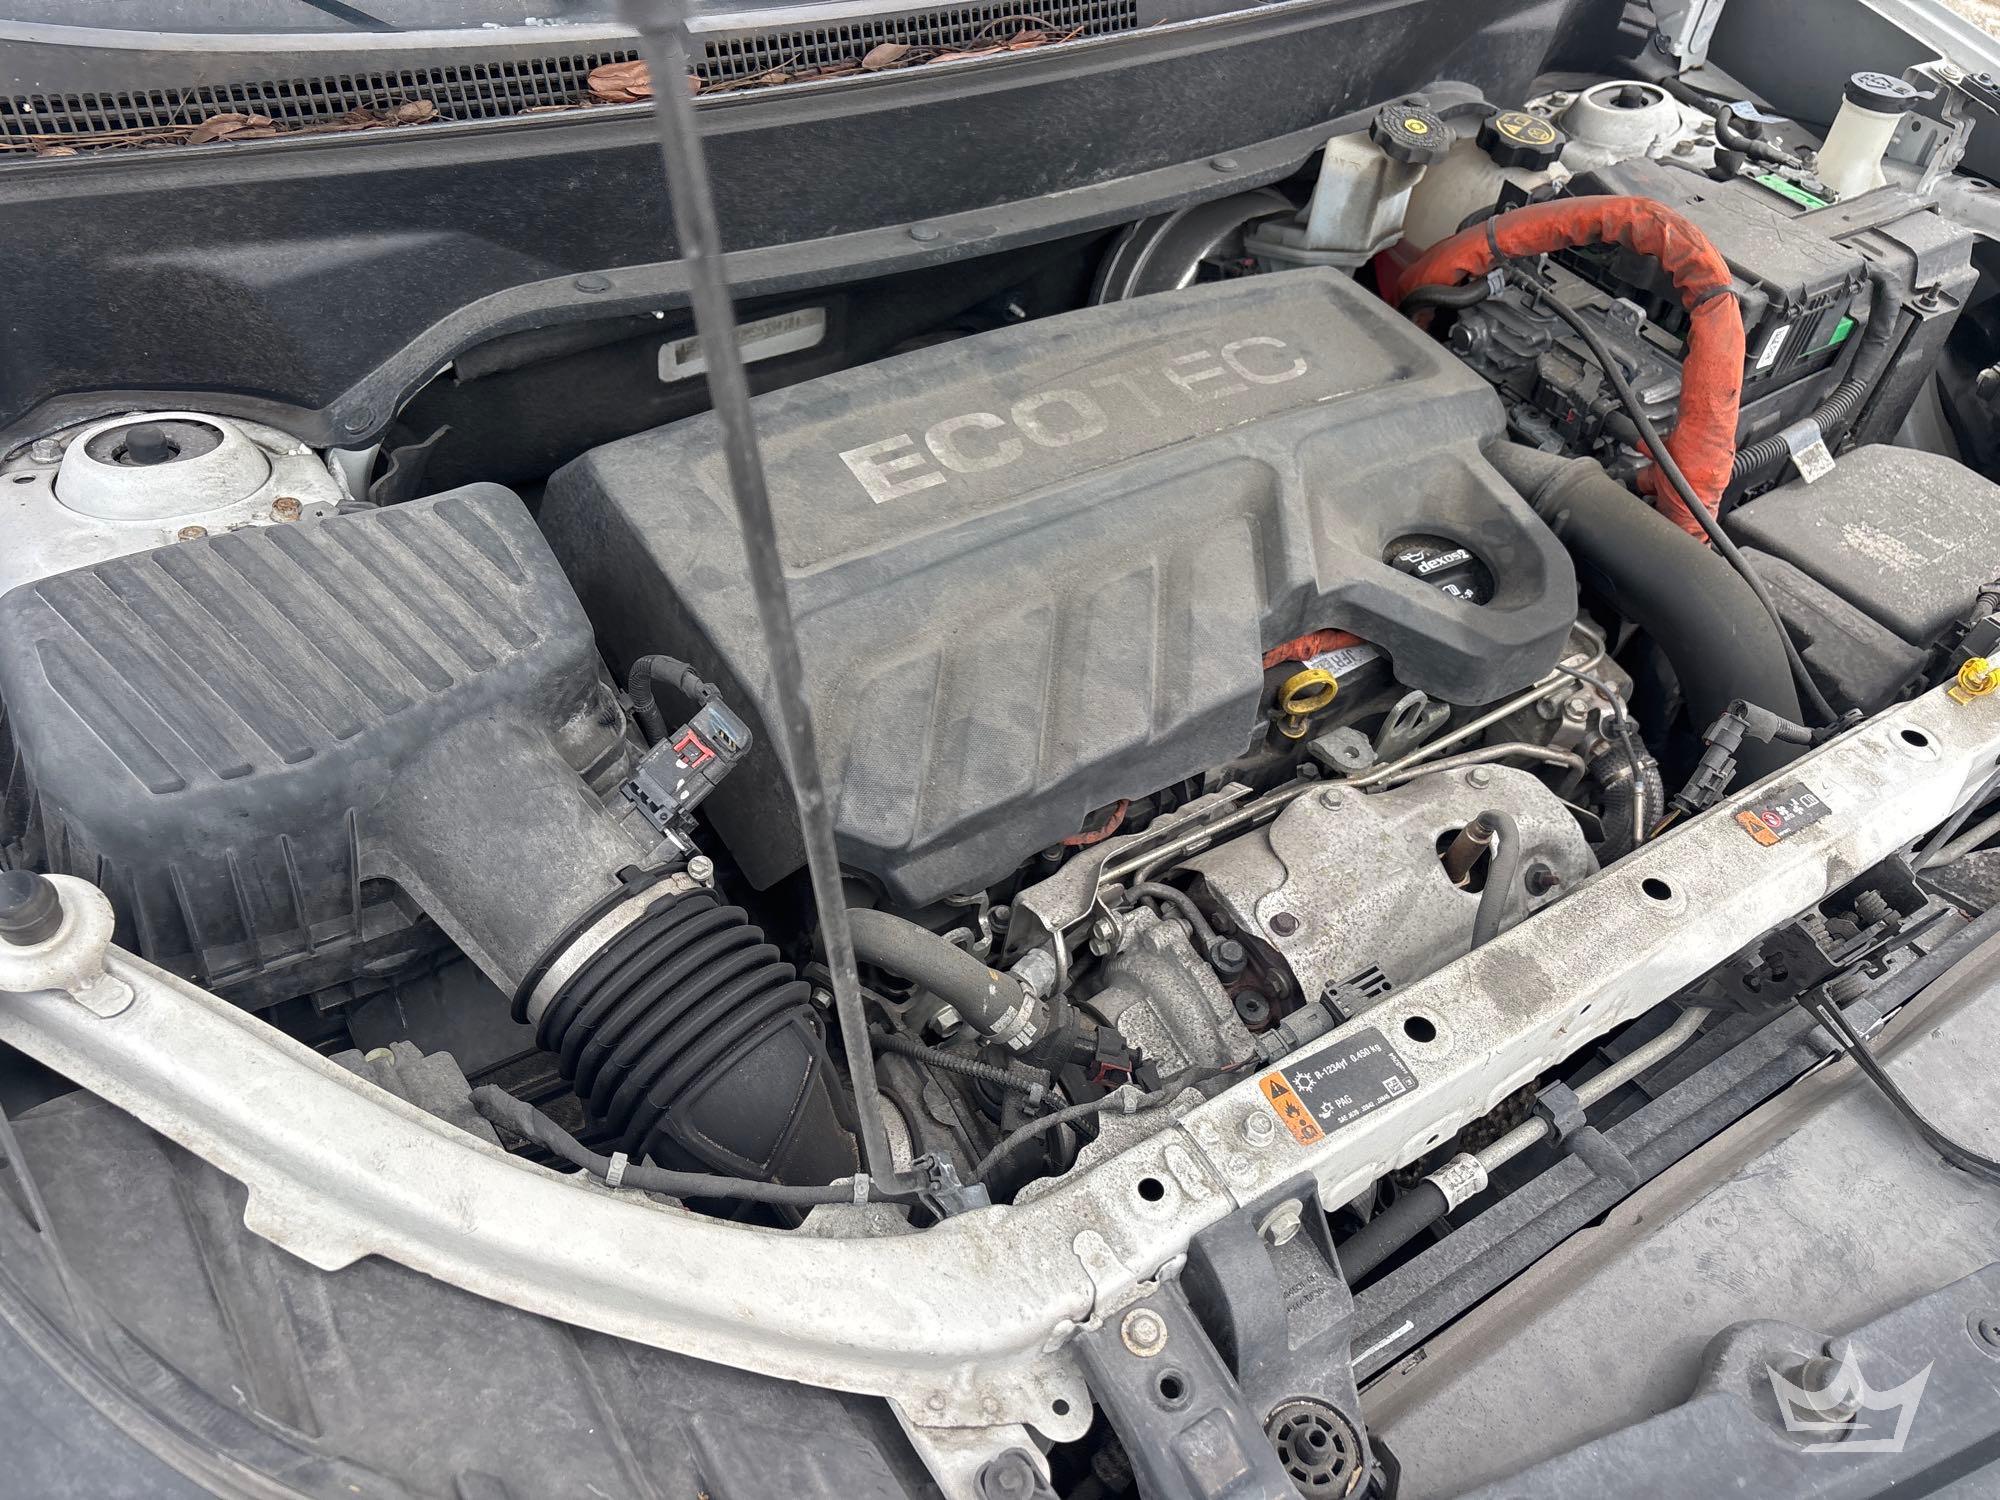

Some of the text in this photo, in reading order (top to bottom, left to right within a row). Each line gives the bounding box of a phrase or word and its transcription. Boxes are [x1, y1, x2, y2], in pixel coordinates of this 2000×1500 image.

[840, 336, 1308, 504] ECOTEC
[1418, 549, 1470, 573] dexos2
[1314, 1043, 1382, 1080] R-1234yf 0.450 kg
[1334, 1094, 1353, 1109] PAG
